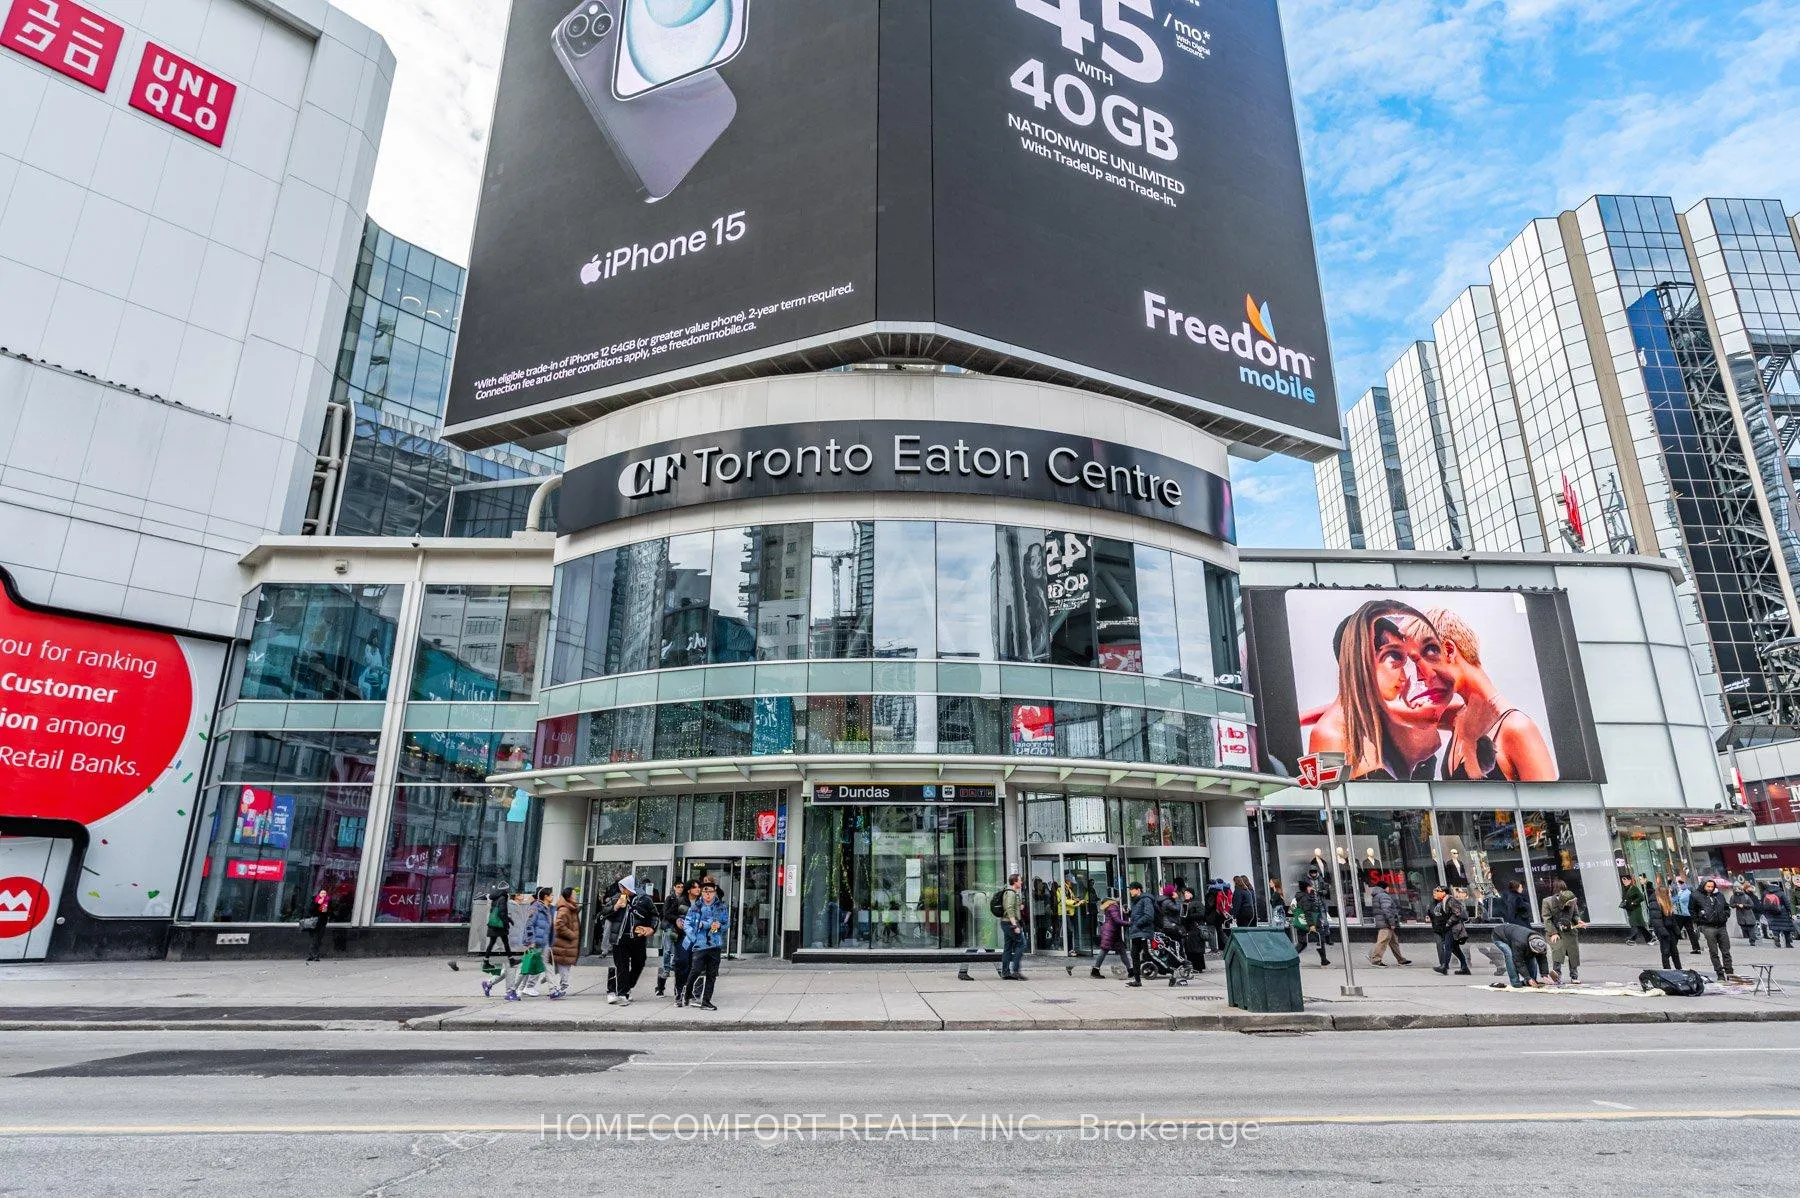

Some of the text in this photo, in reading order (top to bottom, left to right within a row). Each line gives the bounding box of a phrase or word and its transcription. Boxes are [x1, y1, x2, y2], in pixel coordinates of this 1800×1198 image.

[1176, 34, 1211, 56] With Digital
[152, 55, 219, 106] UNI
[1074, 58, 1114, 87] WITH
[145, 82, 217, 132] QLO
[1008, 112, 1186, 196] NATIONWIDE UNLIMITED
[1020, 137, 1177, 208] With TradeUp and Trade-in.
[603, 210, 747, 279] iPhone 15
[497, 368, 525, 386] eligible
[526, 359, 559, 378] trade-in
[559, 356, 570, 369] of
[569, 350, 599, 366] iPhone
[600, 347, 610, 358] 12
[610, 340, 637, 355] 64GB
[636, 336, 650, 350] (or
[650, 326, 684, 346] greater
[684, 321, 710, 337] value
[748, 303, 780, 320] 2-year
[780, 296, 807, 311] term
[807, 282, 855, 304] required.
[475, 321, 757, 401] Connection fee and other conditions apply, see freedommobile.ca.
[1239, 365, 1317, 405] mobile
[617, 434, 1184, 507] CF Toronto Eaton Centre
[39, 640, 71, 662] for
[77, 650, 158, 679] ranking
[1, 672, 119, 704] Customer
[46, 716, 126, 745] among
[0, 745, 141, 777] Retail Banks.
[838, 786, 891, 799] Dundas
[1737, 852, 1761, 865] MUJI
[389, 893, 450, 906] CAKE ATM
